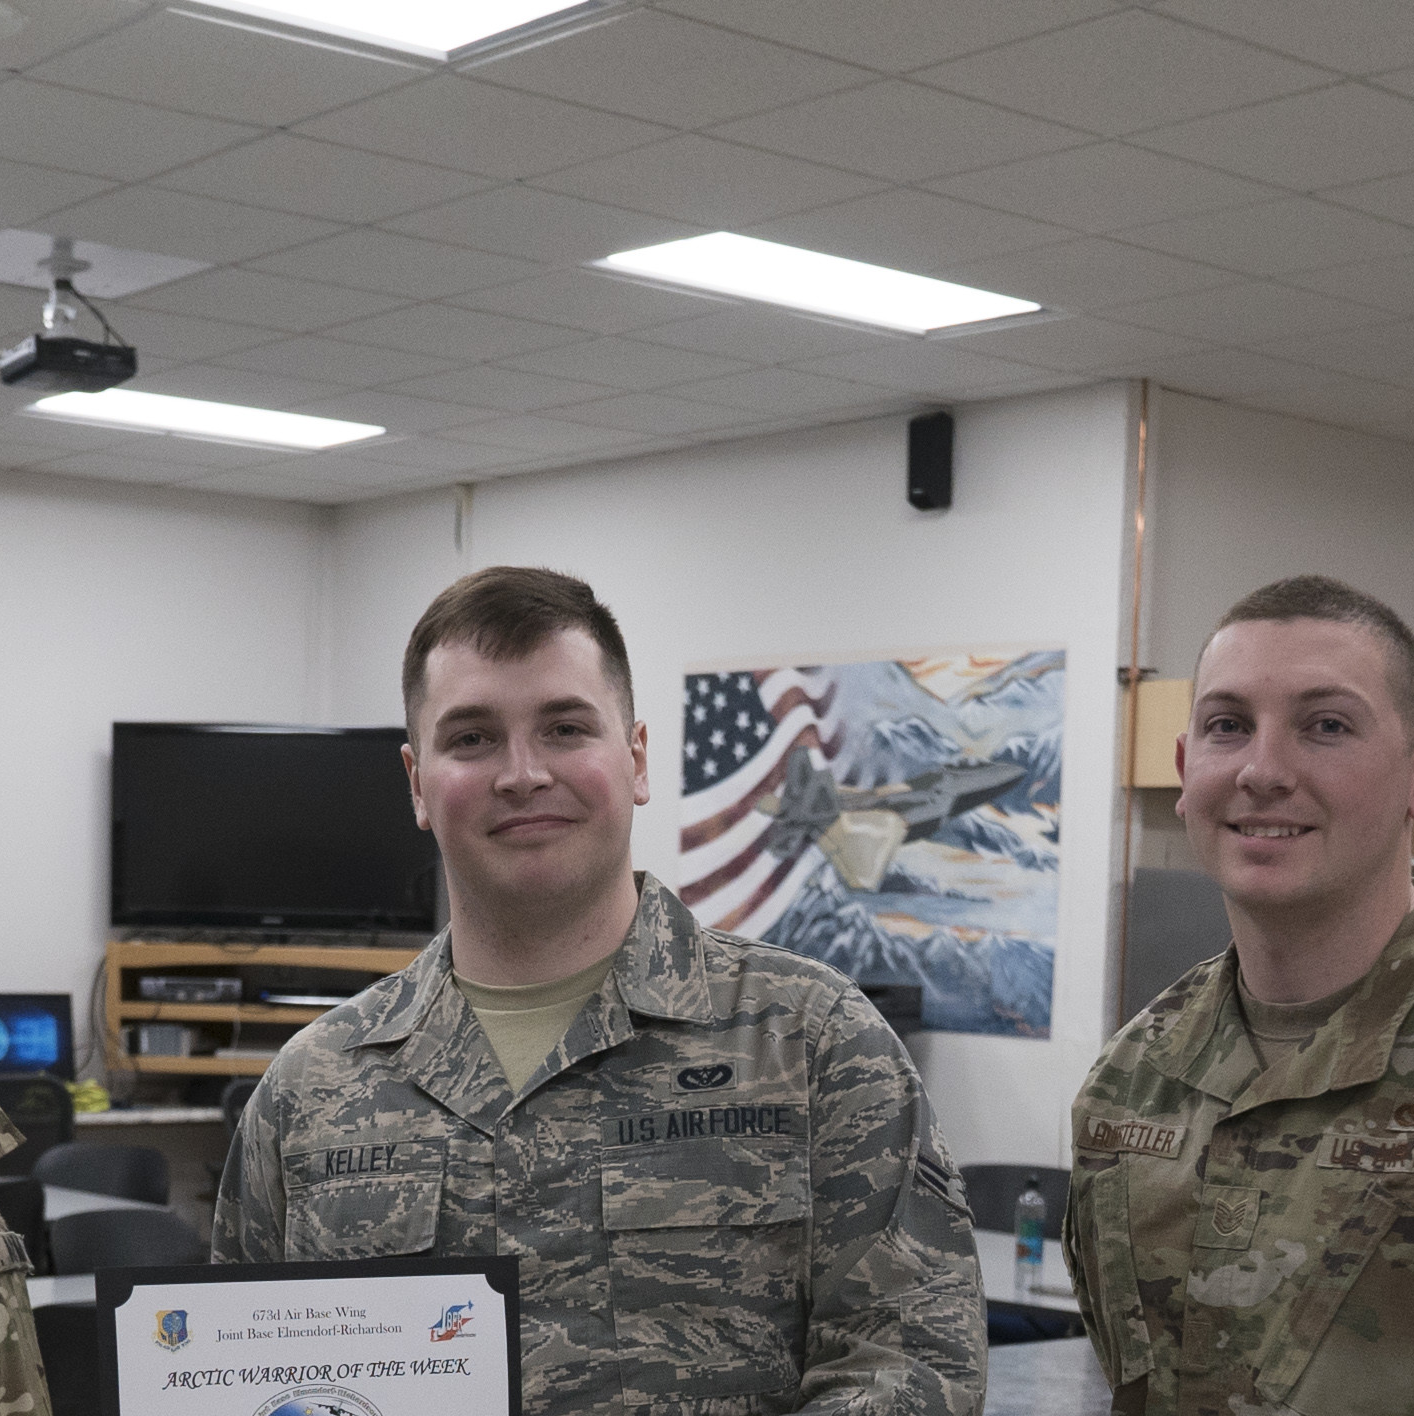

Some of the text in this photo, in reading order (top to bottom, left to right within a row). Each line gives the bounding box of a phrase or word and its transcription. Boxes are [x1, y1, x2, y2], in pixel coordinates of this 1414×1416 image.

[618, 1105, 791, 1145] U.S. AIR FORCE
[326, 1144, 397, 1176] KELLEY
[252, 1306, 366, 1321] 673d Air Base Wing
[216, 1323, 402, 1342] Joint Base Elmendorf-Richardson
[162, 1357, 471, 1390] ARCTIC WARRIOR OF THE WEEK
